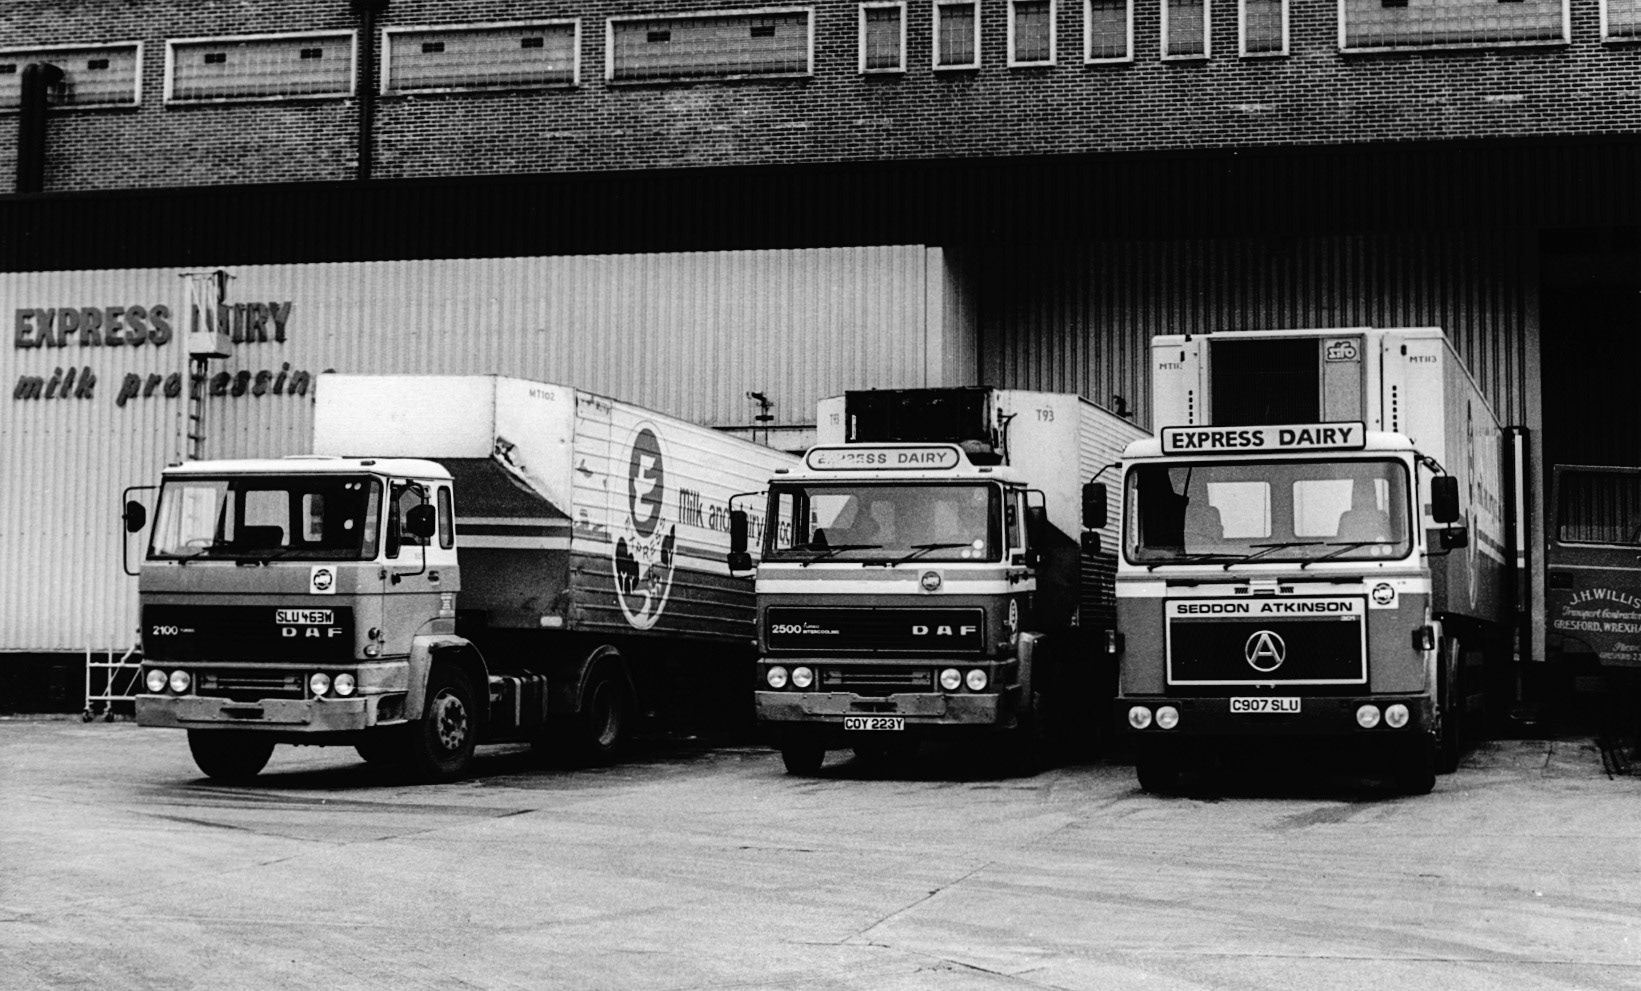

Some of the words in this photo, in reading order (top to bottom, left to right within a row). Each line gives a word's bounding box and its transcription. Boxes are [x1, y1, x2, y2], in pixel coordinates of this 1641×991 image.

[15, 305, 172, 348] EXPRESS
[13, 366, 97, 401] milk
[116, 362, 337, 408] proessin
[1036, 409, 1055, 422] T93
[1172, 430, 1265, 449] EXPRESS
[1279, 428, 1353, 446] DAIRY
[897, 452, 948, 464] DAIRY
[678, 486, 705, 529] milk
[1177, 603, 1249, 614] SEDDON
[1260, 602, 1353, 613] ATKINSON
[277, 611, 299, 623] SLU
[301, 611, 332, 623] 463W
[152, 625, 178, 636] 2100
[282, 627, 343, 638] DAF
[772, 624, 801, 634] 2500
[912, 625, 977, 636] DAF
[1233, 699, 1269, 711] C907
[1271, 699, 1299, 711] SLU
[846, 718, 869, 729] COY
[871, 718, 904, 729] 223Y
